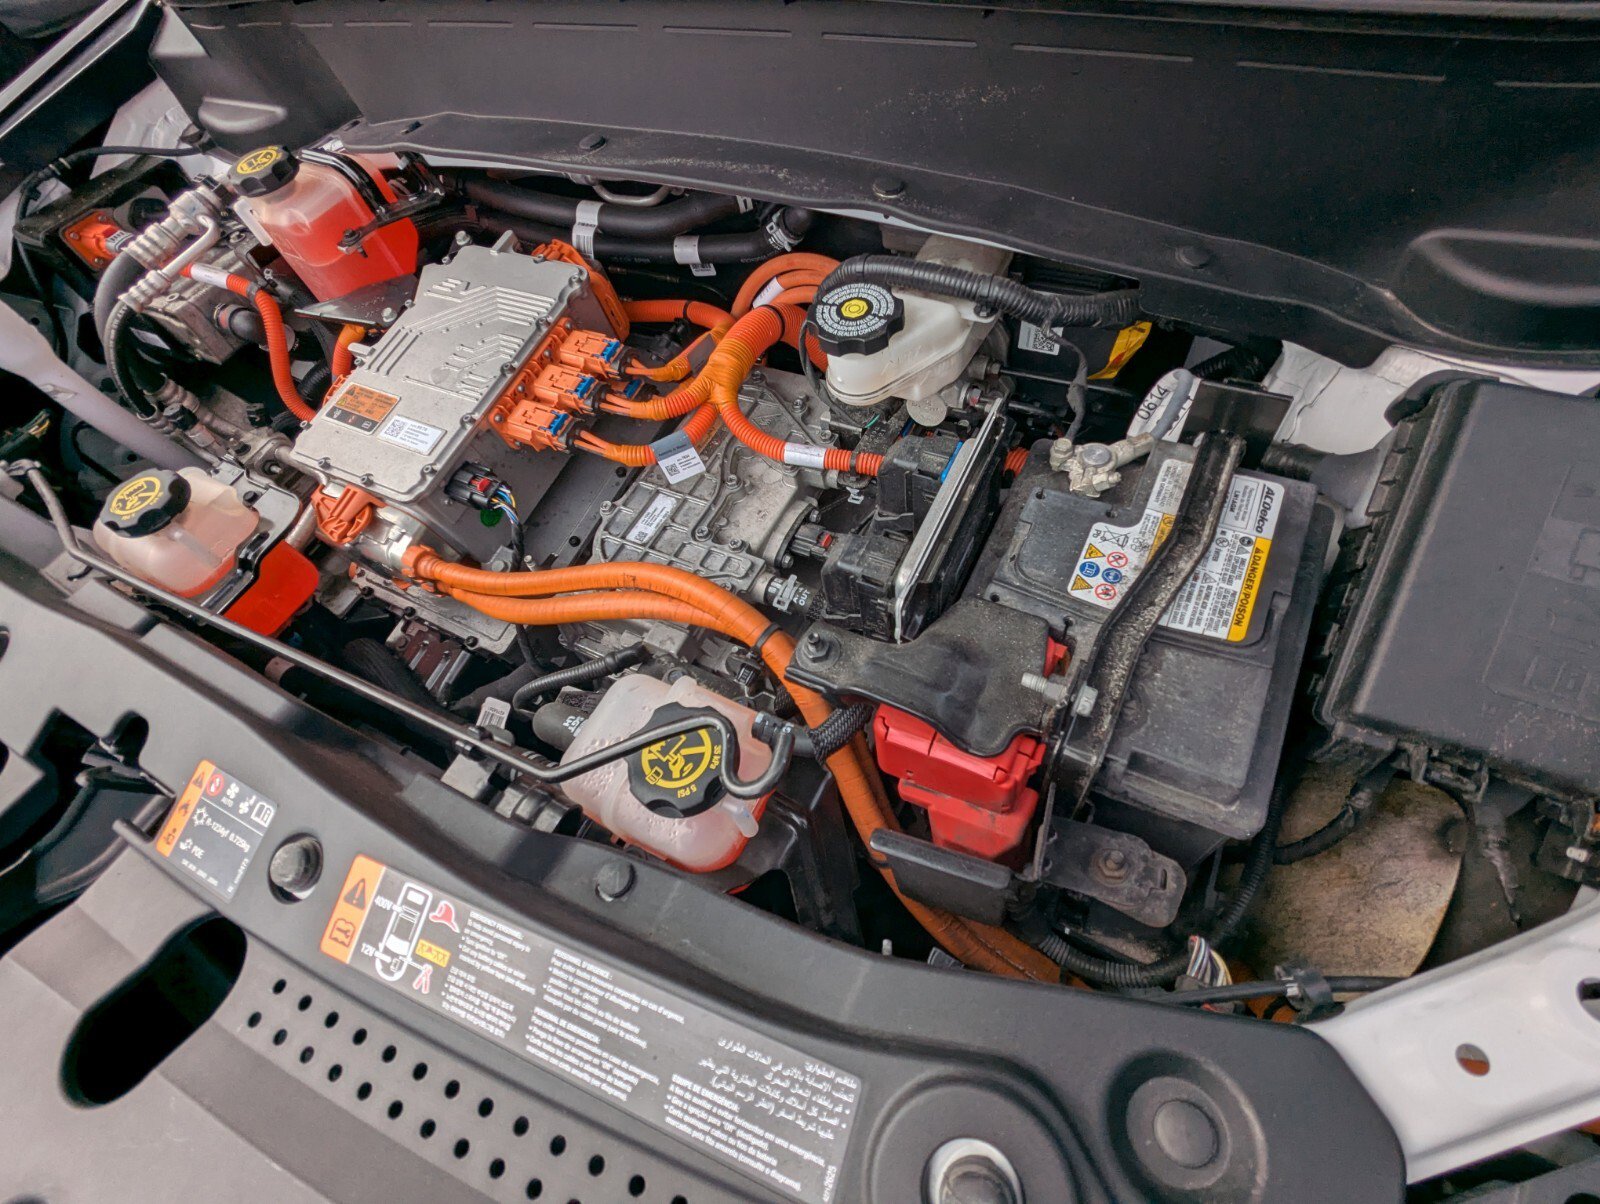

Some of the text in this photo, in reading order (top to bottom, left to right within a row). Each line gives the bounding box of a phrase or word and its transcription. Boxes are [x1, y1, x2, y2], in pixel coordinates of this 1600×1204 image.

[1137, 384, 1170, 420] 0614
[1254, 486, 1276, 533] ACDelco
[1233, 555, 1261, 626] DANGER/POISON
[677, 788, 690, 798] PSI
[374, 895, 392, 912] 400V
[360, 943, 375, 958] 12V
